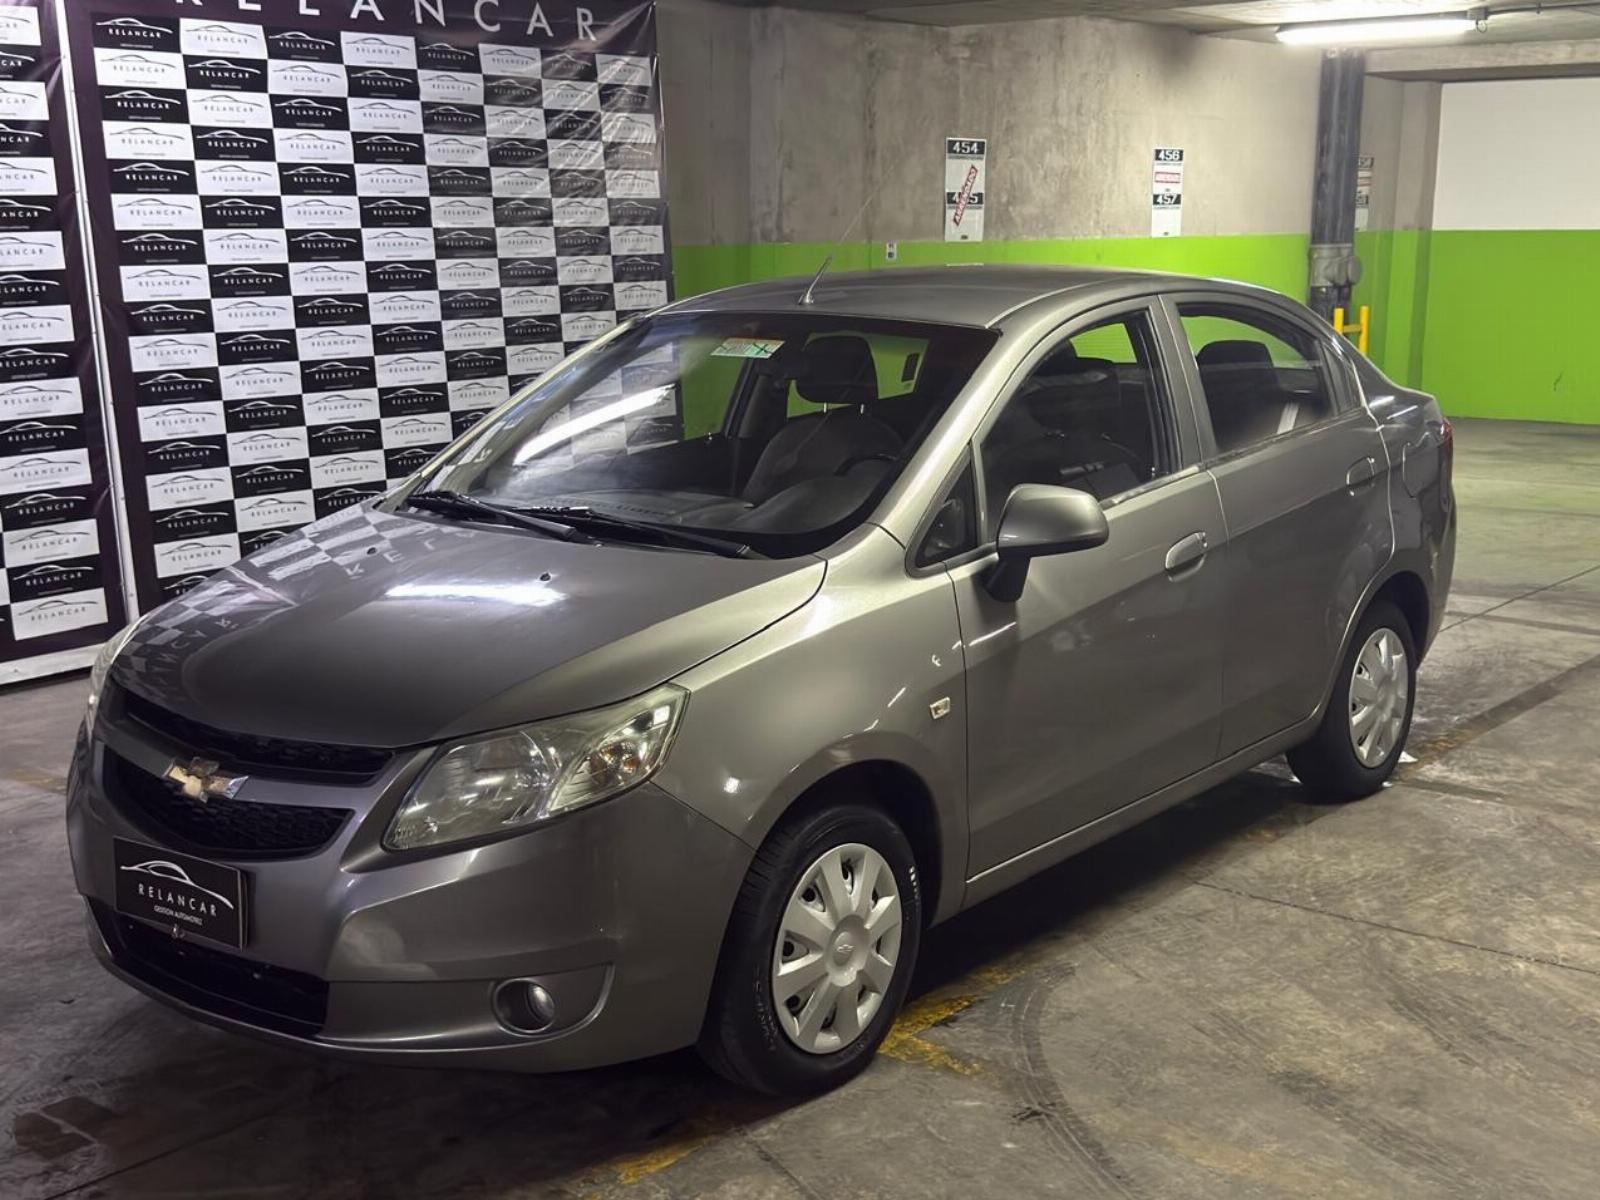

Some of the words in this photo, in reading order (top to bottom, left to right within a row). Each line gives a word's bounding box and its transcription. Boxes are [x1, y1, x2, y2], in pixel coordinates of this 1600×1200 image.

[109, 29, 161, 38] RELANCAR
[198, 35, 248, 44] RELANCAR
[280, 41, 327, 50] RELANCAR
[356, 47, 400, 55] RELANCAR
[113, 65, 165, 73] RELANCAR
[201, 70, 250, 79] RELANCAR
[283, 75, 331, 83] RELANCAR
[205, 105, 254, 113] RELANCAR
[953, 142, 978, 154] 454
[952, 193, 978, 204] 45
[1157, 193, 1178, 204] 457
[0, 285, 47, 293] LANCAR
[385, 334, 428, 342] RELANCAR
[232, 343, 281, 351] RELANCAR
[312, 339, 357, 347] RELANCAR
[147, 349, 198, 357] RELANCAR
[389, 365, 431, 373] RELANCAR
[315, 371, 360, 379] RELANCAR
[236, 377, 284, 386] RELANCAR
[151, 383, 202, 391] RELANCAR
[4, 395, 60, 405] RELANCAR
[392, 396, 434, 405] RELANCAR
[318, 402, 363, 411] RELANCAR
[239, 409, 287, 418] RELANCAR
[155, 417, 206, 426] RELANCAR
[394, 426, 436, 435] RELANCAR
[8, 430, 65, 441] RELANCAR
[322, 433, 366, 443] RELANCAR
[243, 441, 291, 451] RELANCAR
[159, 450, 210, 460] RELANCAR
[13, 466, 70, 478] RELANCAR
[325, 464, 369, 475] RELANCAR
[247, 473, 294, 484] RELANCAR
[164, 484, 214, 493] RELANCAR
[19, 502, 74, 515] RELANCAR
[250, 505, 297, 517] RELANCAR
[167, 517, 218, 528] RELANCAR
[22, 537, 78, 550] RELANCAR
[171, 550, 222, 561] RELANCAR
[25, 571, 82, 586] RELANCAR
[31, 606, 86, 621] RELANCAR
[138, 883, 217, 917] RELANCAR
